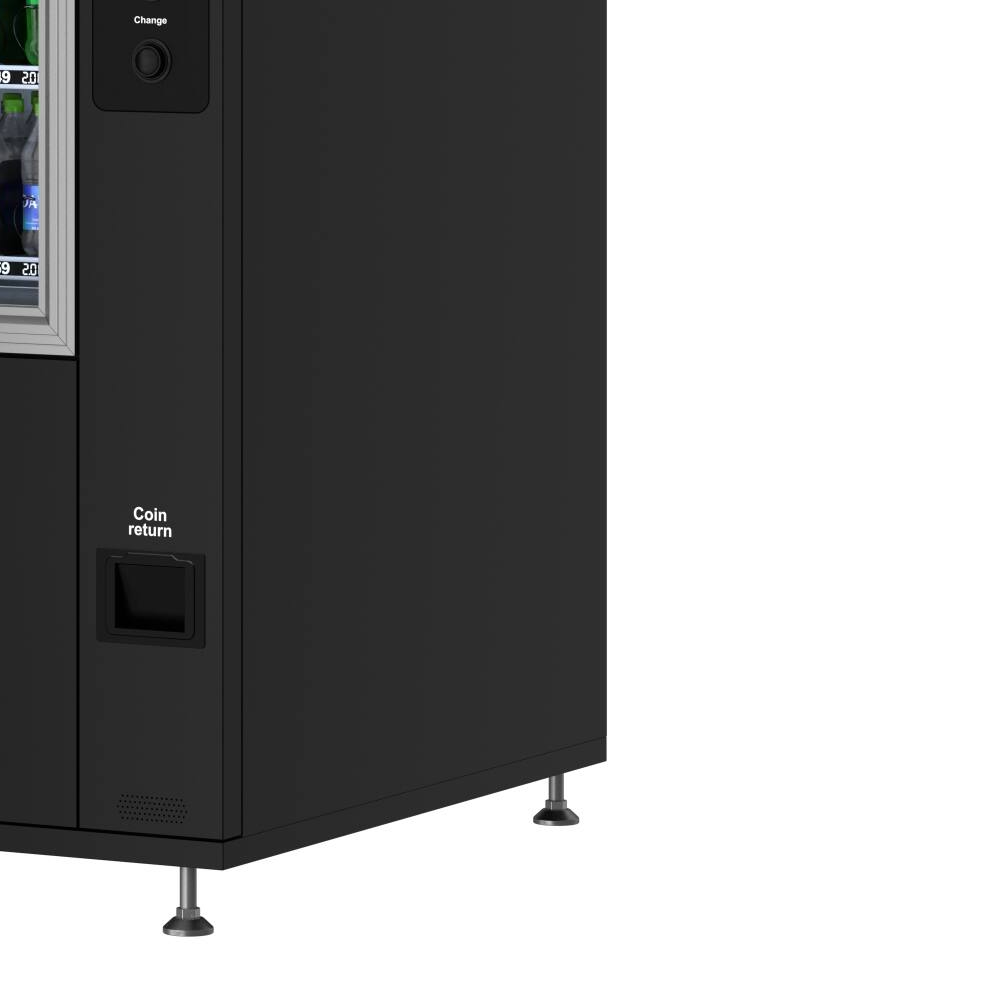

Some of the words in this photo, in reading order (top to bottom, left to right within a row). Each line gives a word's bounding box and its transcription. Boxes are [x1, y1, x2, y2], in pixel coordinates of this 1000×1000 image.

[134, 16, 168, 26] Change
[22, 263, 38, 276] 2.0
[134, 506, 166, 522] Coin
[128, 523, 172, 538] return
